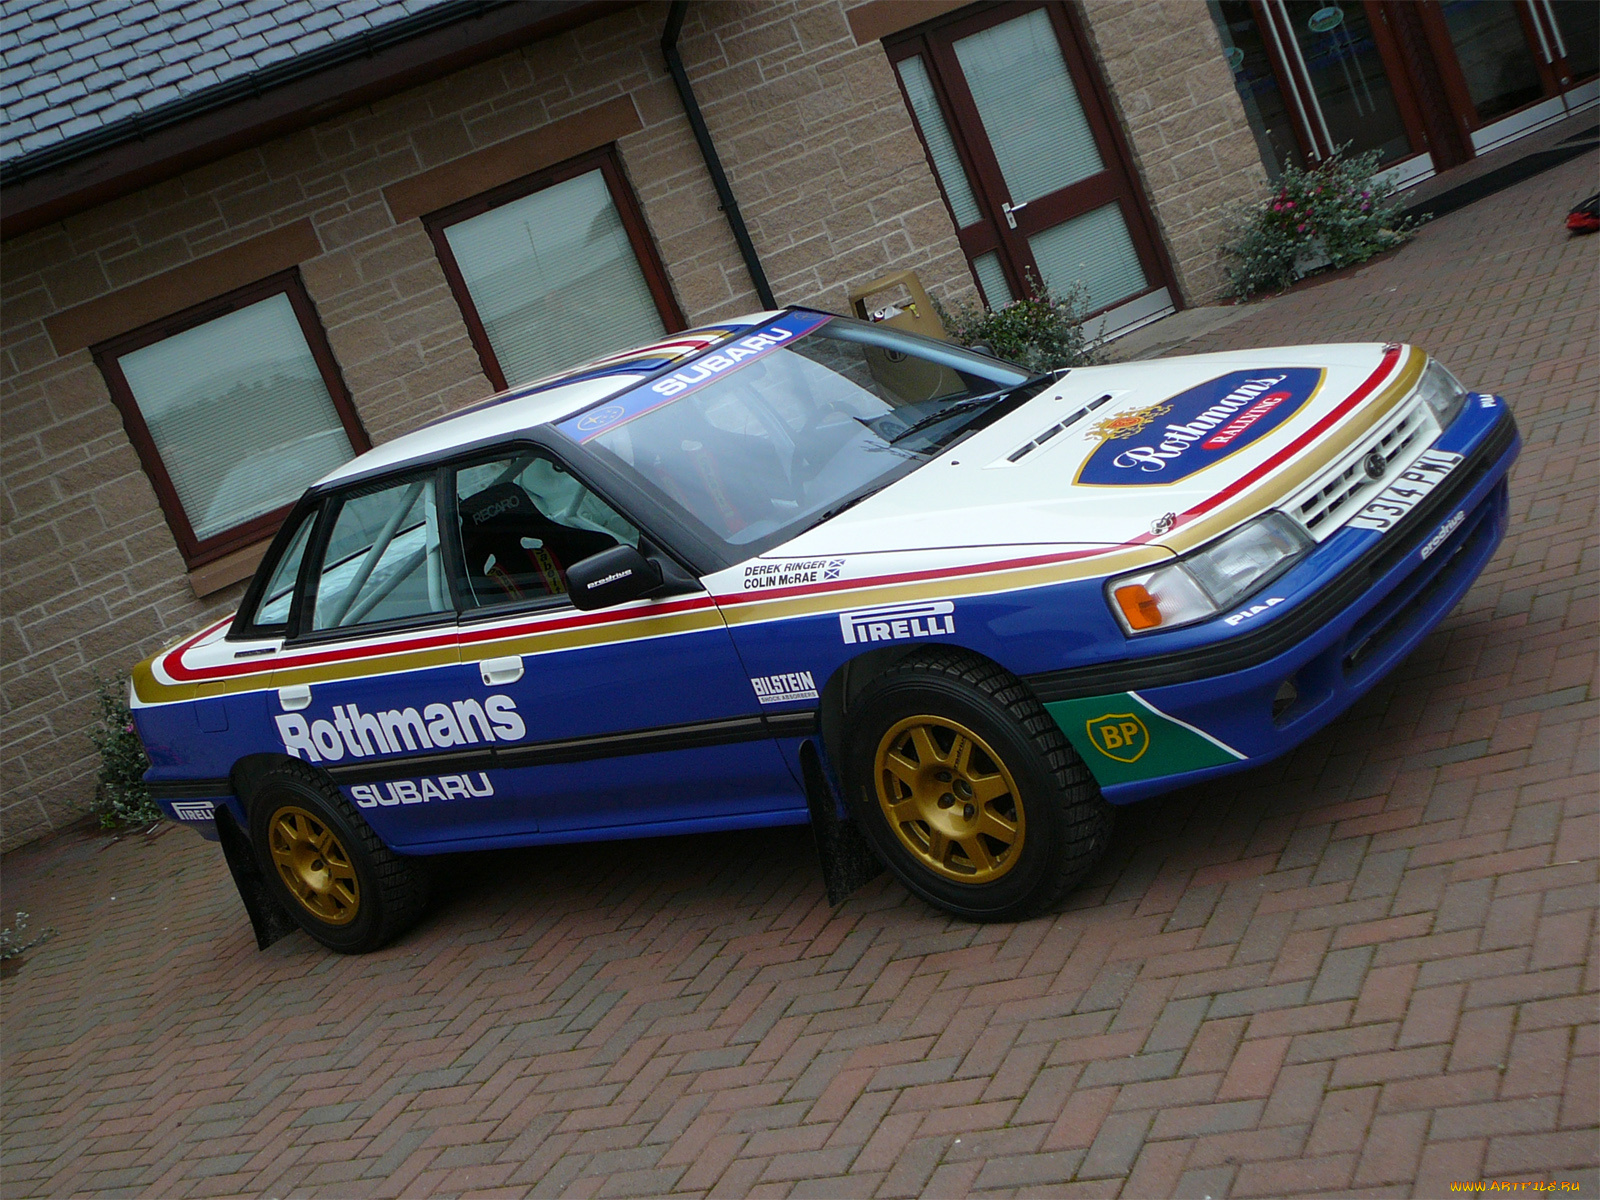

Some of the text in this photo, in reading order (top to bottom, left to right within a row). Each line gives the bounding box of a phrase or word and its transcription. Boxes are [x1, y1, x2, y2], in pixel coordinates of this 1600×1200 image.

[652, 327, 793, 397] SUBARU
[1113, 375, 1288, 472] Rothmans
[1210, 396, 1283, 444] RALLYING
[1356, 455, 1462, 529] J314 PWL
[472, 495, 520, 526] RECARO
[1420, 509, 1467, 561] prodrive
[587, 569, 633, 589] prodrive
[744, 560, 827, 577] DEREK RINGER
[744, 572, 817, 589] COLIN McRAE
[839, 601, 956, 644] PIRELLI
[1224, 598, 1286, 627] PIAA
[750, 671, 816, 696] BILSTEIN
[275, 694, 526, 762] Rothmans
[1100, 722, 1139, 749] BP
[351, 772, 495, 808] SUBARU
[171, 801, 216, 820] PIRELL
